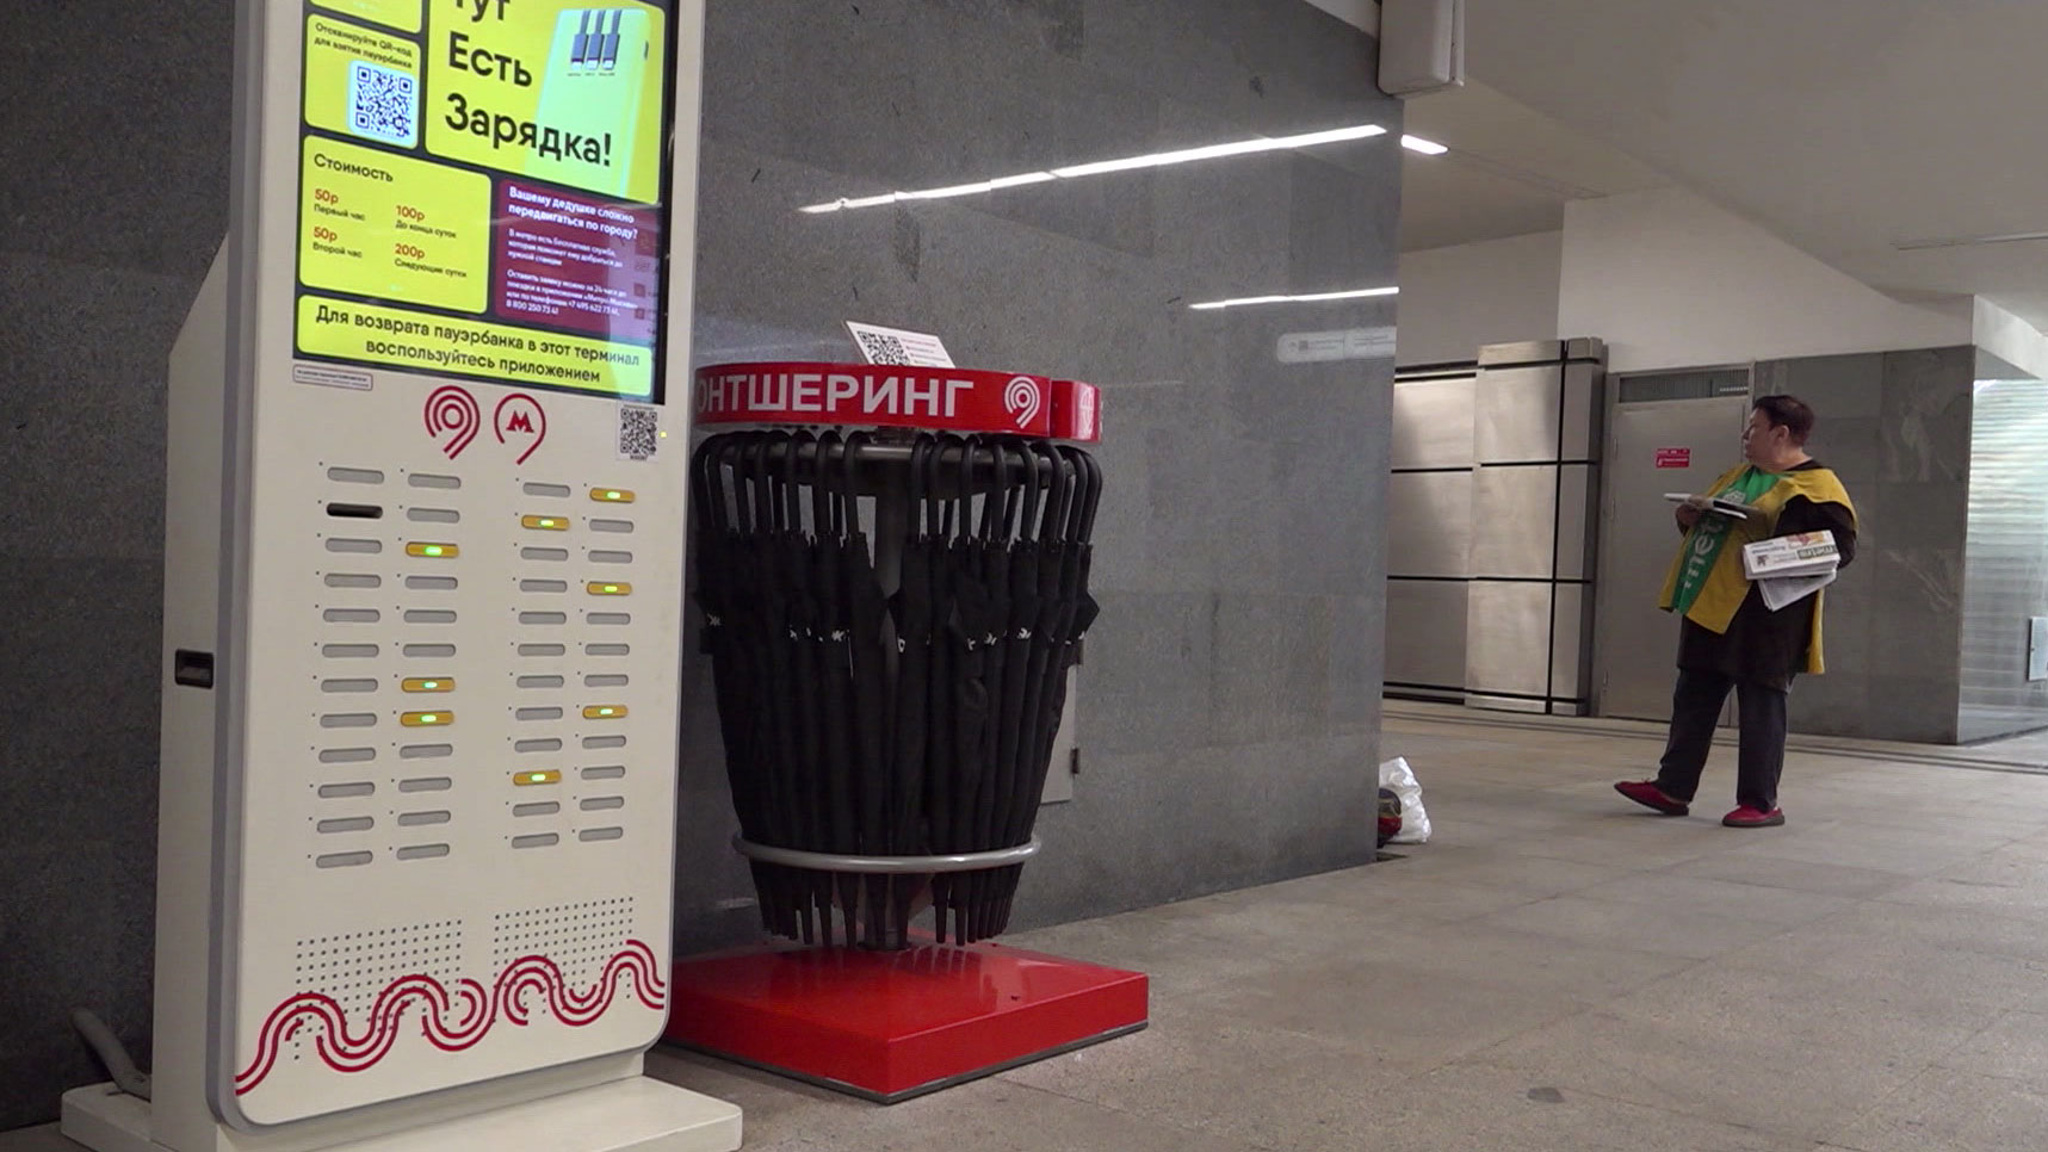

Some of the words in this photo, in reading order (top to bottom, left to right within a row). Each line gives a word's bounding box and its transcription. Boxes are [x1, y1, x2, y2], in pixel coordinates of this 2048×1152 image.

[315, 22, 377, 47] Отсканируйте
[379, 40, 412, 58] QR-код
[314, 37, 331, 47] для
[362, 49, 412, 69] пауэрбанка
[449, 31, 533, 88] Есть
[445, 92, 612, 167] Зарядка!
[314, 153, 394, 183] Стоимость
[314, 188, 339, 205] 50р
[509, 186, 551, 207] Вашему
[551, 198, 596, 216] дедушке
[597, 208, 635, 224] сложно
[314, 203, 349, 219] Первый
[350, 211, 366, 221] час
[396, 205, 426, 222] 100р
[508, 204, 584, 229] передвигаться
[586, 220, 599, 231] по
[600, 224, 638, 240] городу?
[313, 226, 338, 243] 50р
[395, 220, 408, 230] До
[409, 223, 434, 236] конца
[435, 228, 457, 239] суток
[313, 241, 345, 255] Второй
[347, 249, 363, 258] час
[395, 243, 426, 260] 200р
[394, 258, 443, 275] Следующие
[445, 267, 467, 278] сутки
[507, 268, 539, 283] Оставить
[316, 305, 349, 324] Для
[354, 314, 429, 335] возврата
[434, 325, 524, 349] пауэрбанка
[527, 340, 536, 351] в
[540, 341, 571, 356] этот
[575, 346, 640, 366] терминал
[366, 340, 495, 368] воспользуйтесь
[500, 358, 600, 382] приложением
